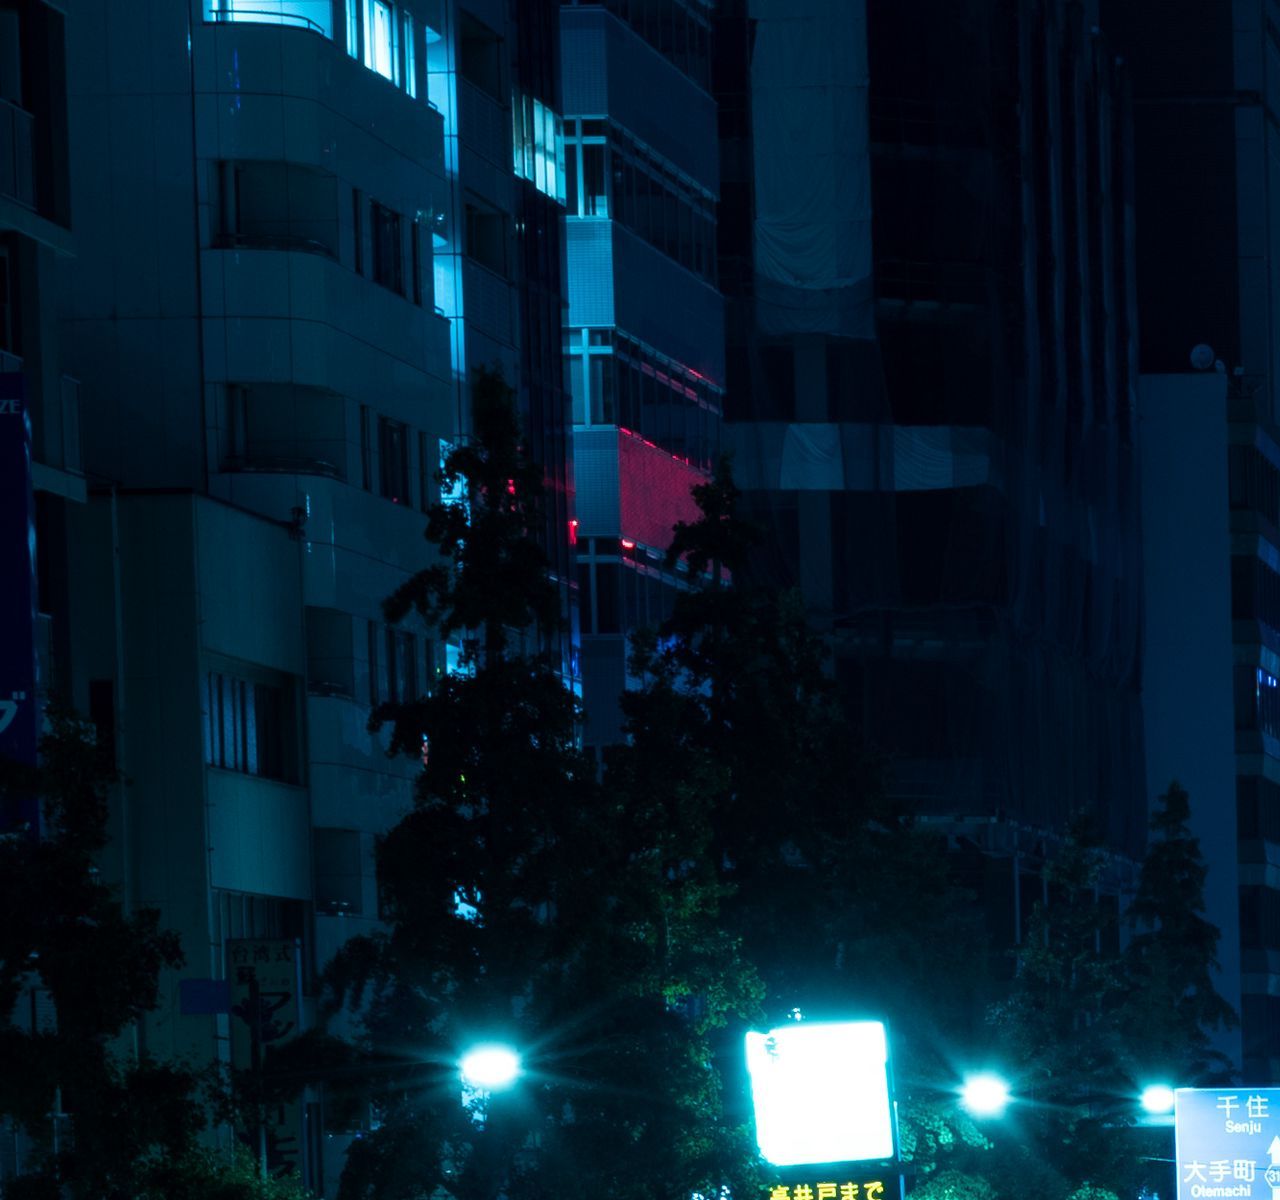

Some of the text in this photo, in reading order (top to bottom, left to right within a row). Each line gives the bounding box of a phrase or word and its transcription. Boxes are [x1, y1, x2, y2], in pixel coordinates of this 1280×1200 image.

[1216, 1095, 1269, 1118] 千住
[1225, 1121, 1261, 1135] Senju
[1184, 1160, 1256, 1182] 大手町
[1191, 1184, 1251, 1197] Otemachi
